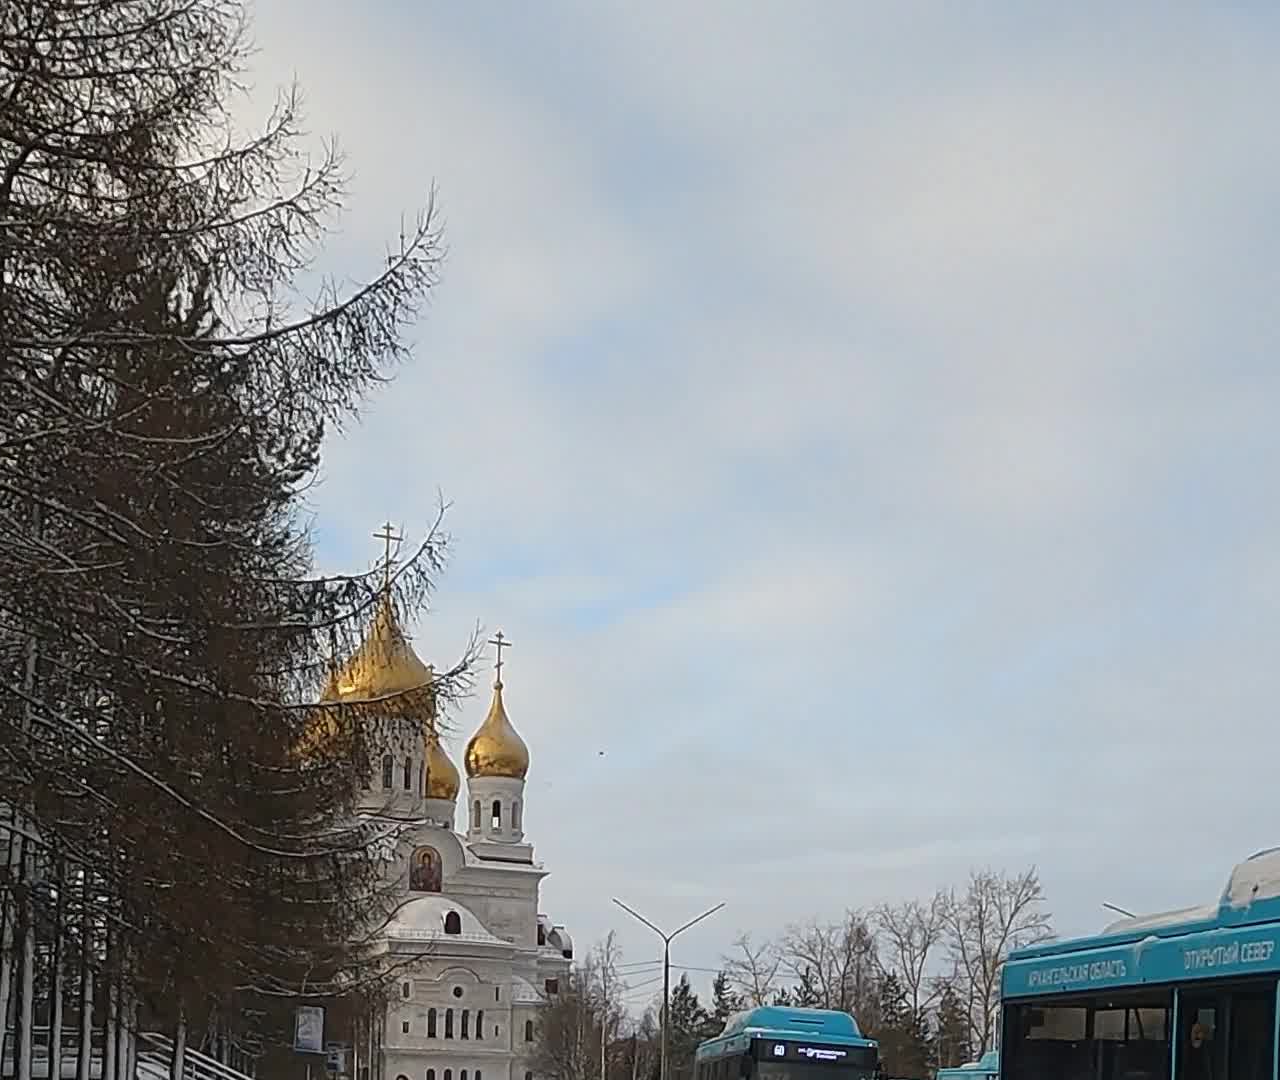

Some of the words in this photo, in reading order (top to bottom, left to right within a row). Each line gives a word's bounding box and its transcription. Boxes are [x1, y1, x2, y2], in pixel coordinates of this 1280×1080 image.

[1184, 942, 1239, 970] ОТКРЫТЫЙ
[1240, 940, 1275, 963] СЕВЕР
[1028, 963, 1089, 987] АРХАНГЕЛЬСКАЯ
[1089, 959, 1127, 981] ОБЛАСТЬ
[773, 1045, 785, 1056] 60
